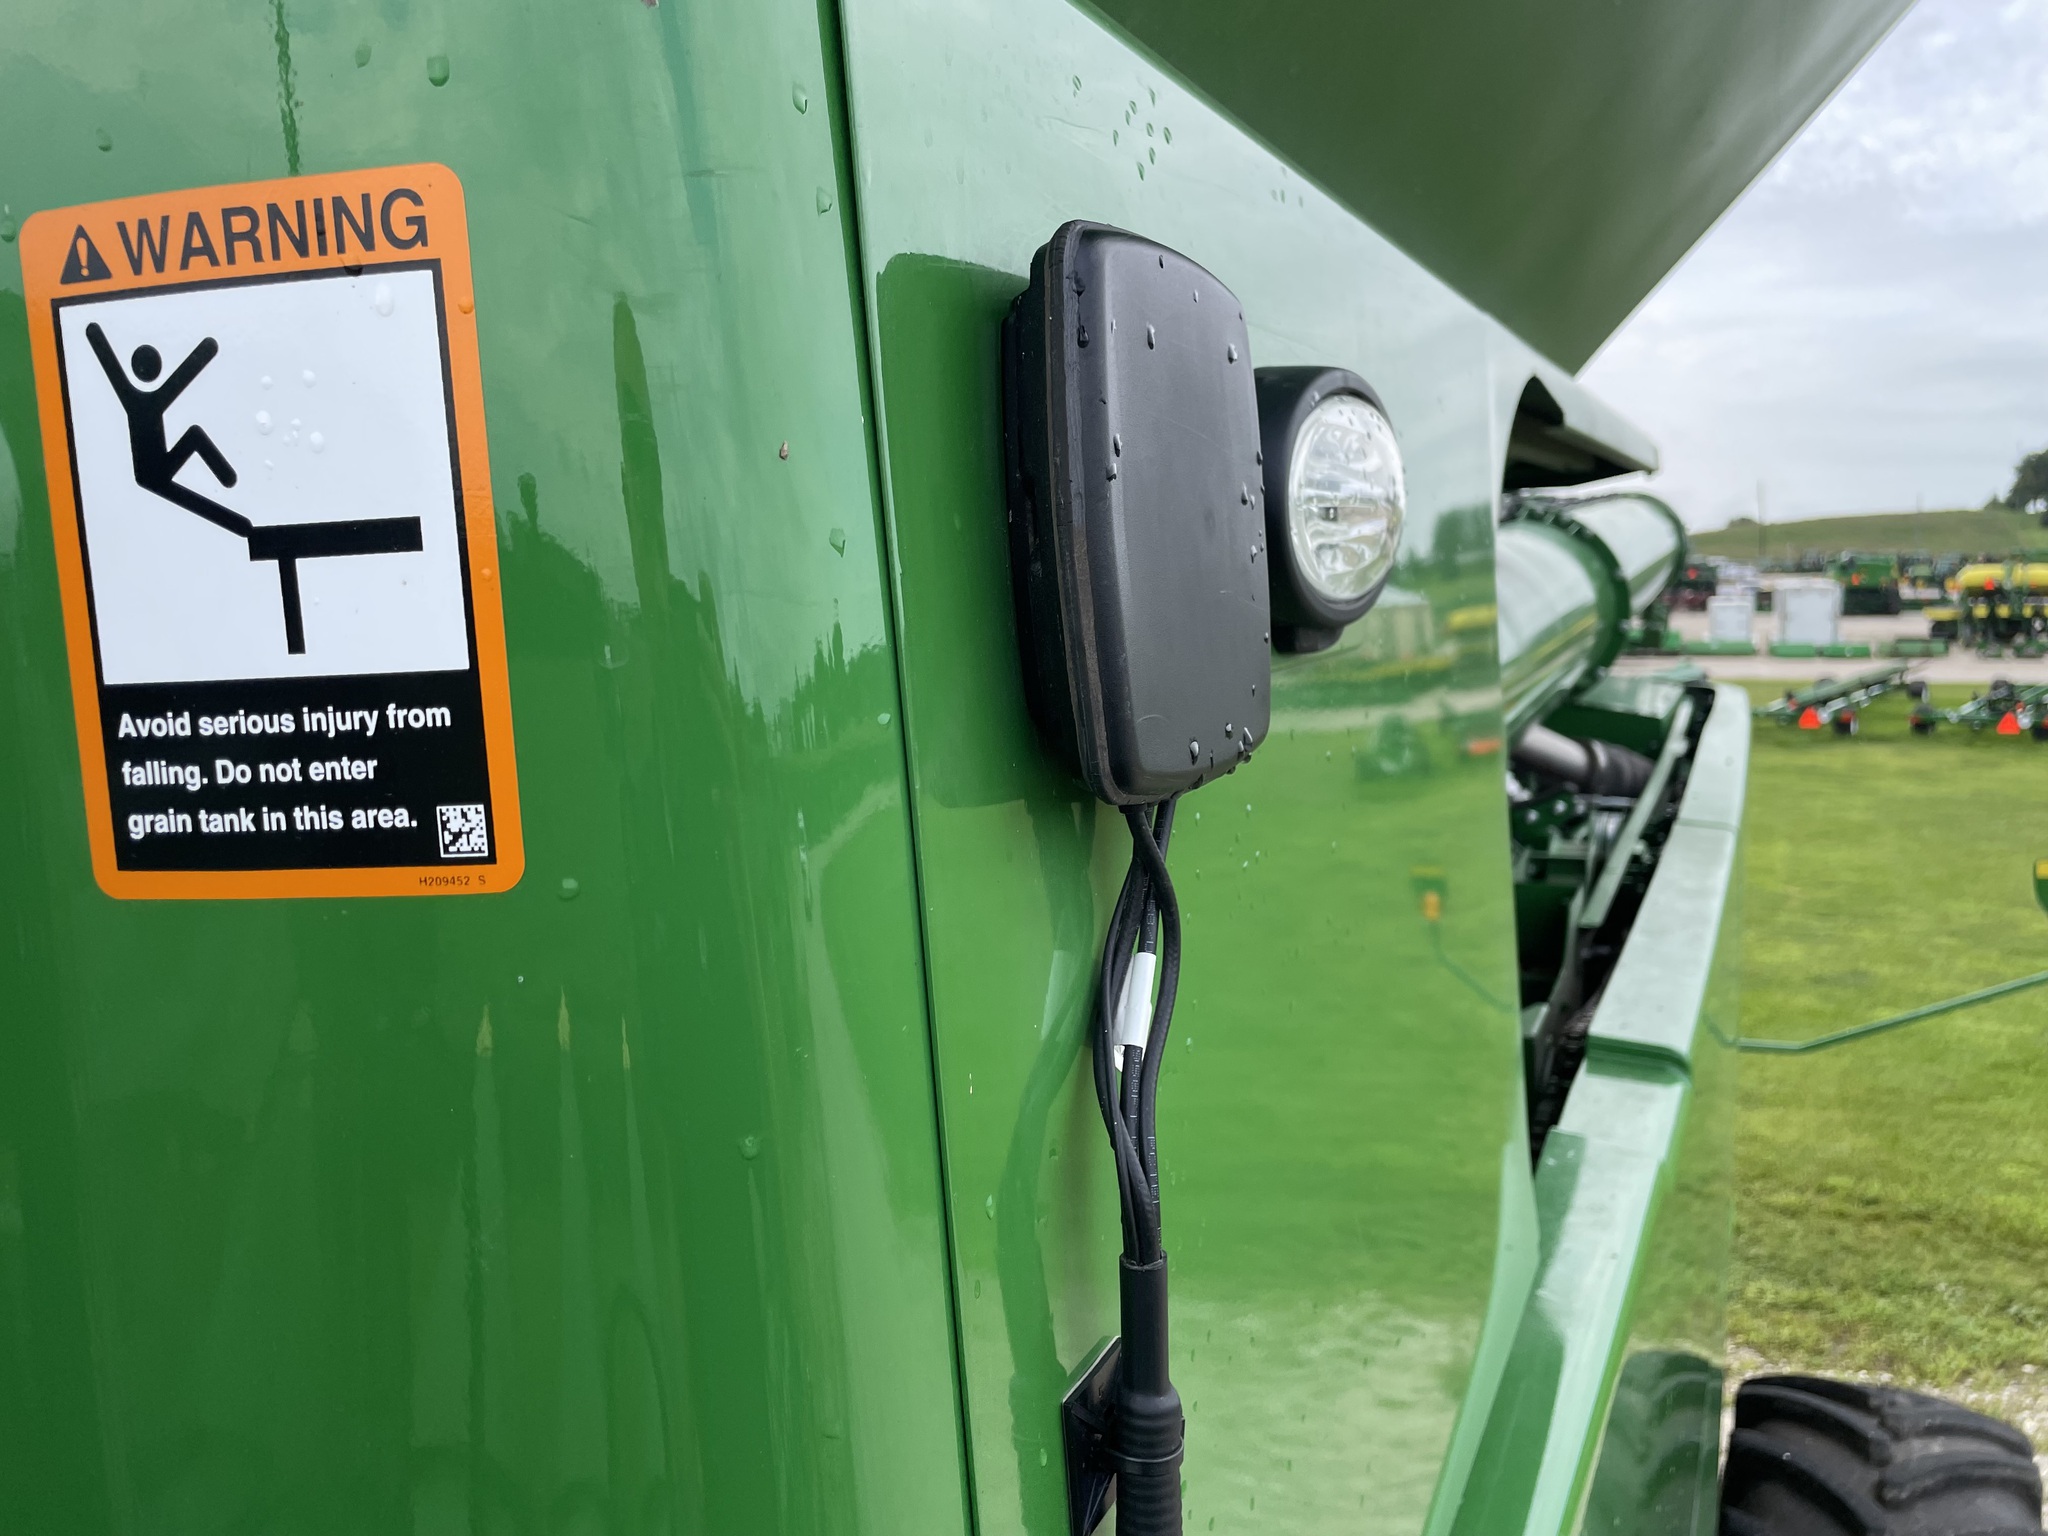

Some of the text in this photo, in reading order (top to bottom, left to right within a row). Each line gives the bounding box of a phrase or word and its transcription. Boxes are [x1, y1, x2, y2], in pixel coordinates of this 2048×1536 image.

[117, 188, 428, 276] WARNING
[118, 703, 451, 738] Avoid serious injury from
[122, 757, 377, 791] falling. Do not enter
[128, 805, 417, 839] grain tank in this area.
[419, 875, 486, 886] H209452 S
